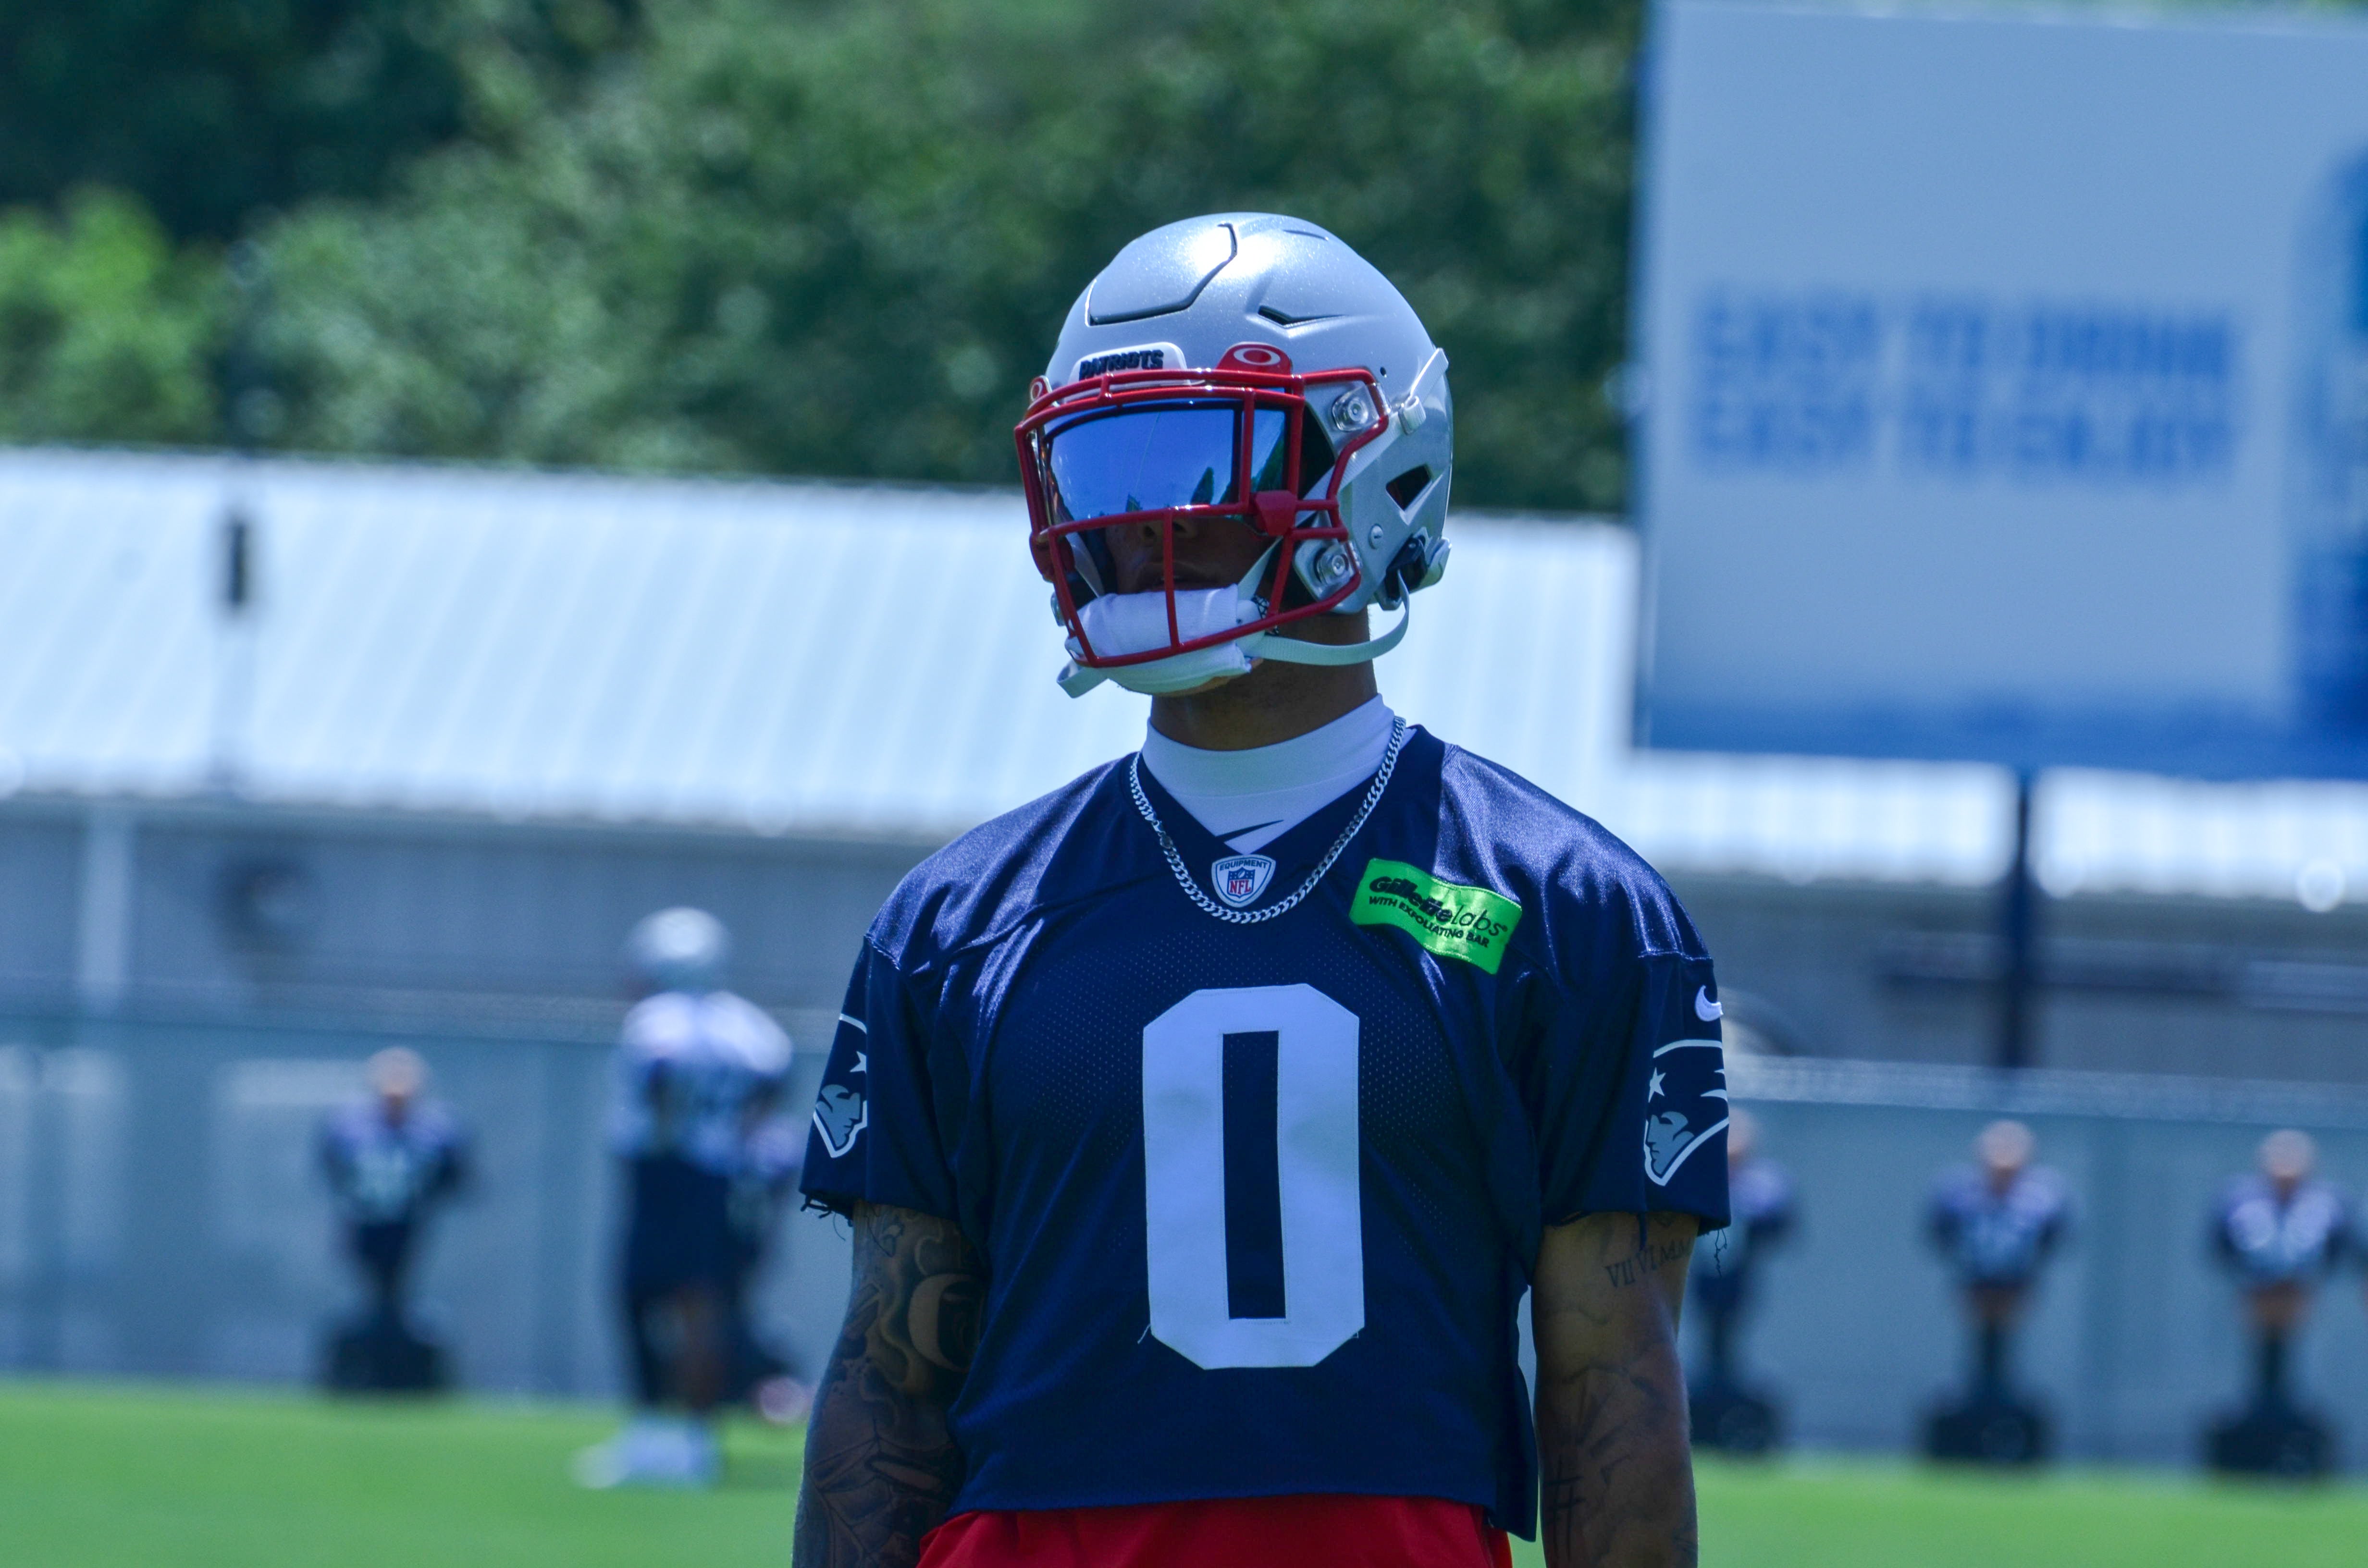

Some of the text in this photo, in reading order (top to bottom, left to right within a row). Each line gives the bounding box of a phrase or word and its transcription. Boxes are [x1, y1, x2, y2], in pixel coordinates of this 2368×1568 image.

[1079, 350, 1164, 380] PATRIOTS
[1220, 859, 1268, 871] EQUIPMENT
[1229, 880, 1251, 894] NFL
[1369, 896, 1490, 948] WITH EXFOLIATING BAR
[1143, 983, 1365, 1370] 0
